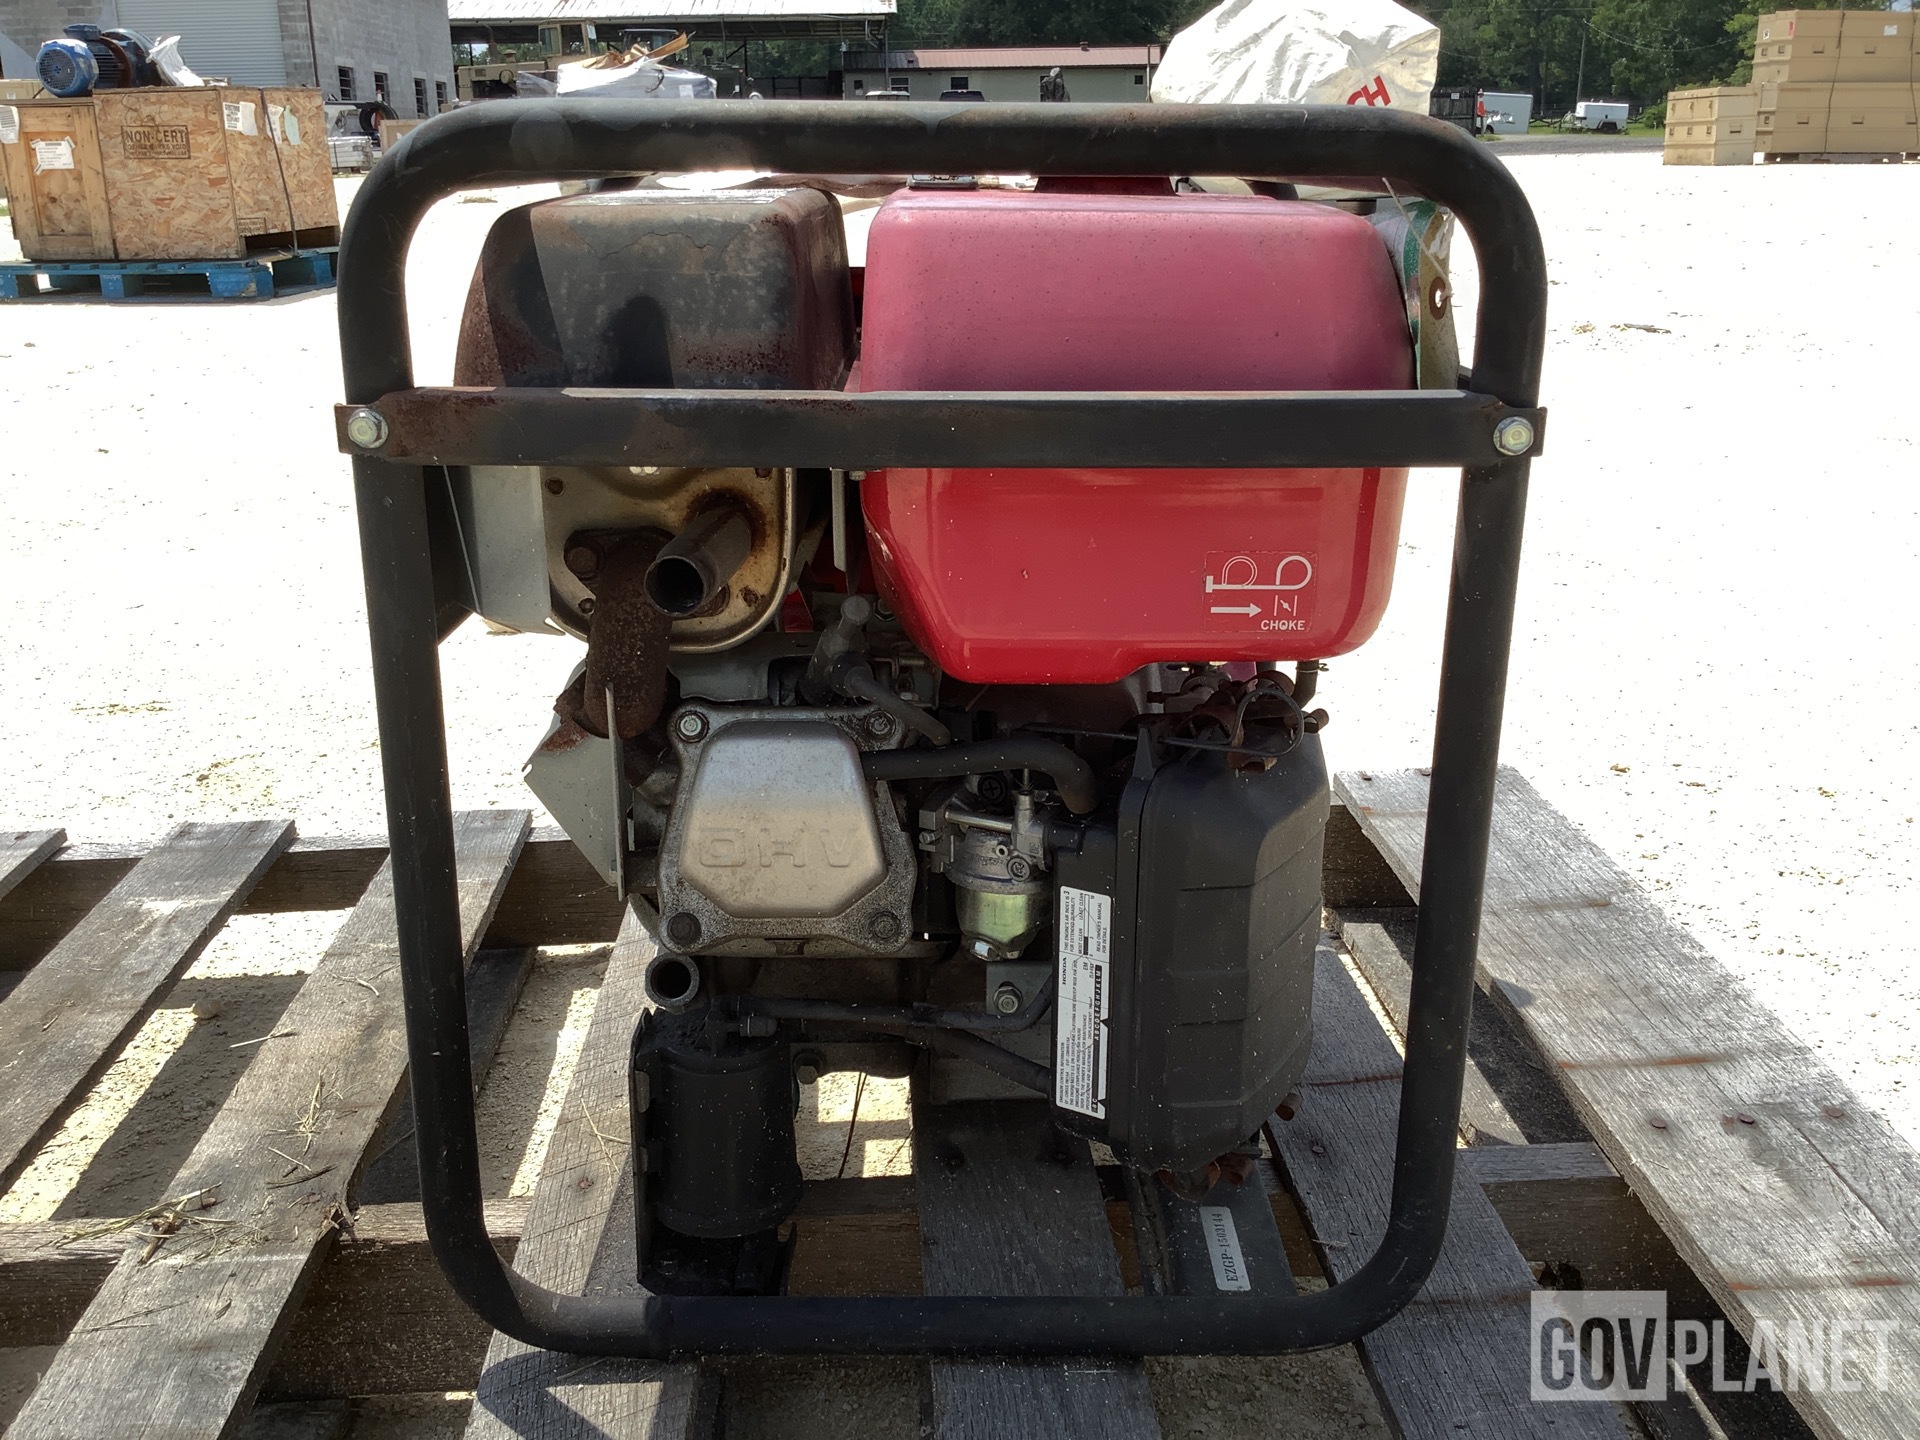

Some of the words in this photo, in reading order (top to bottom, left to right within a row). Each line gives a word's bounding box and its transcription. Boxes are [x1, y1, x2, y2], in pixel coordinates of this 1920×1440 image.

[1261, 620, 1305, 631] CHOKE
[699, 827, 860, 868] OHV
[1083, 962, 1088, 971] EM
